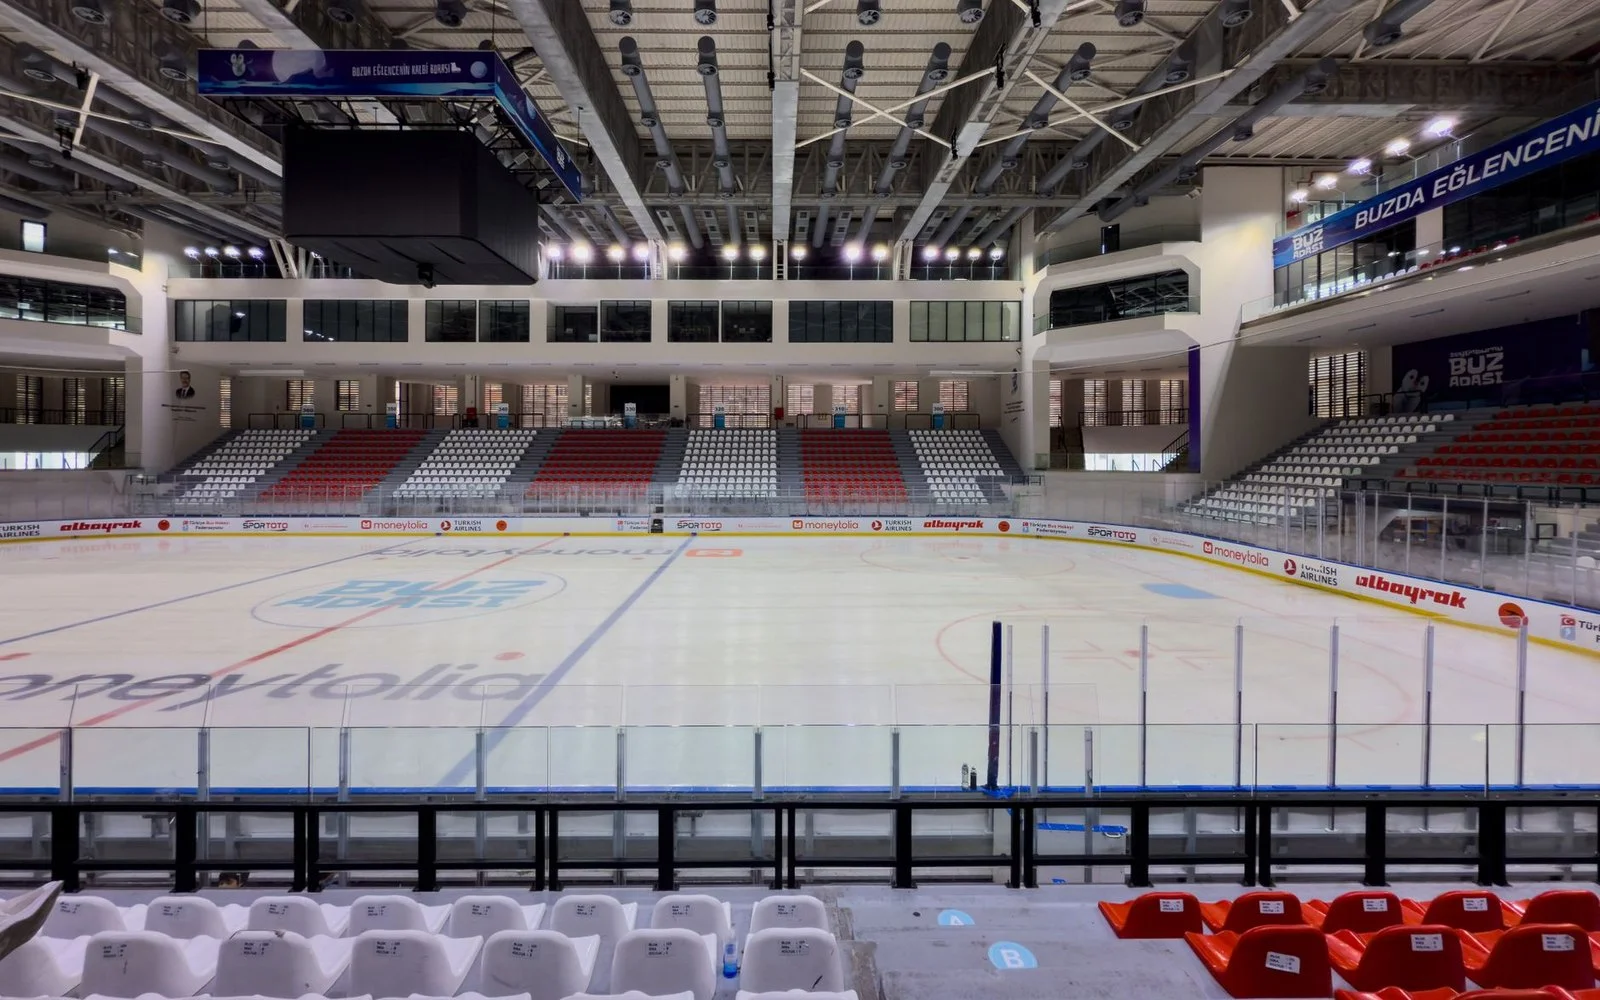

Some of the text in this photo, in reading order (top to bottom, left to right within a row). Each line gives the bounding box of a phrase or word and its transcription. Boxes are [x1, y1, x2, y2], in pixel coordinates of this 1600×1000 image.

[1354, 187, 1425, 230] BUZDA
[1292, 228, 1324, 250] BUZ
[1292, 241, 1324, 259] ADASI
[1448, 352, 1504, 376] BUZ
[1449, 371, 1503, 387] ADASI
[60, 520, 141, 532] albayrak
[373, 520, 428, 531] moneytolia
[805, 520, 859, 531] moneytolia
[923, 520, 984, 531] albayrak
[1214, 546, 1269, 567] moneytolia
[1300, 571, 1338, 586] AIRLINES
[318, 580, 547, 595] BUZ
[1356, 574, 1467, 609] albayrak
[273, 595, 523, 608] ADASI
[950, 915, 965, 925] A
[1000, 949, 1025, 968] B
